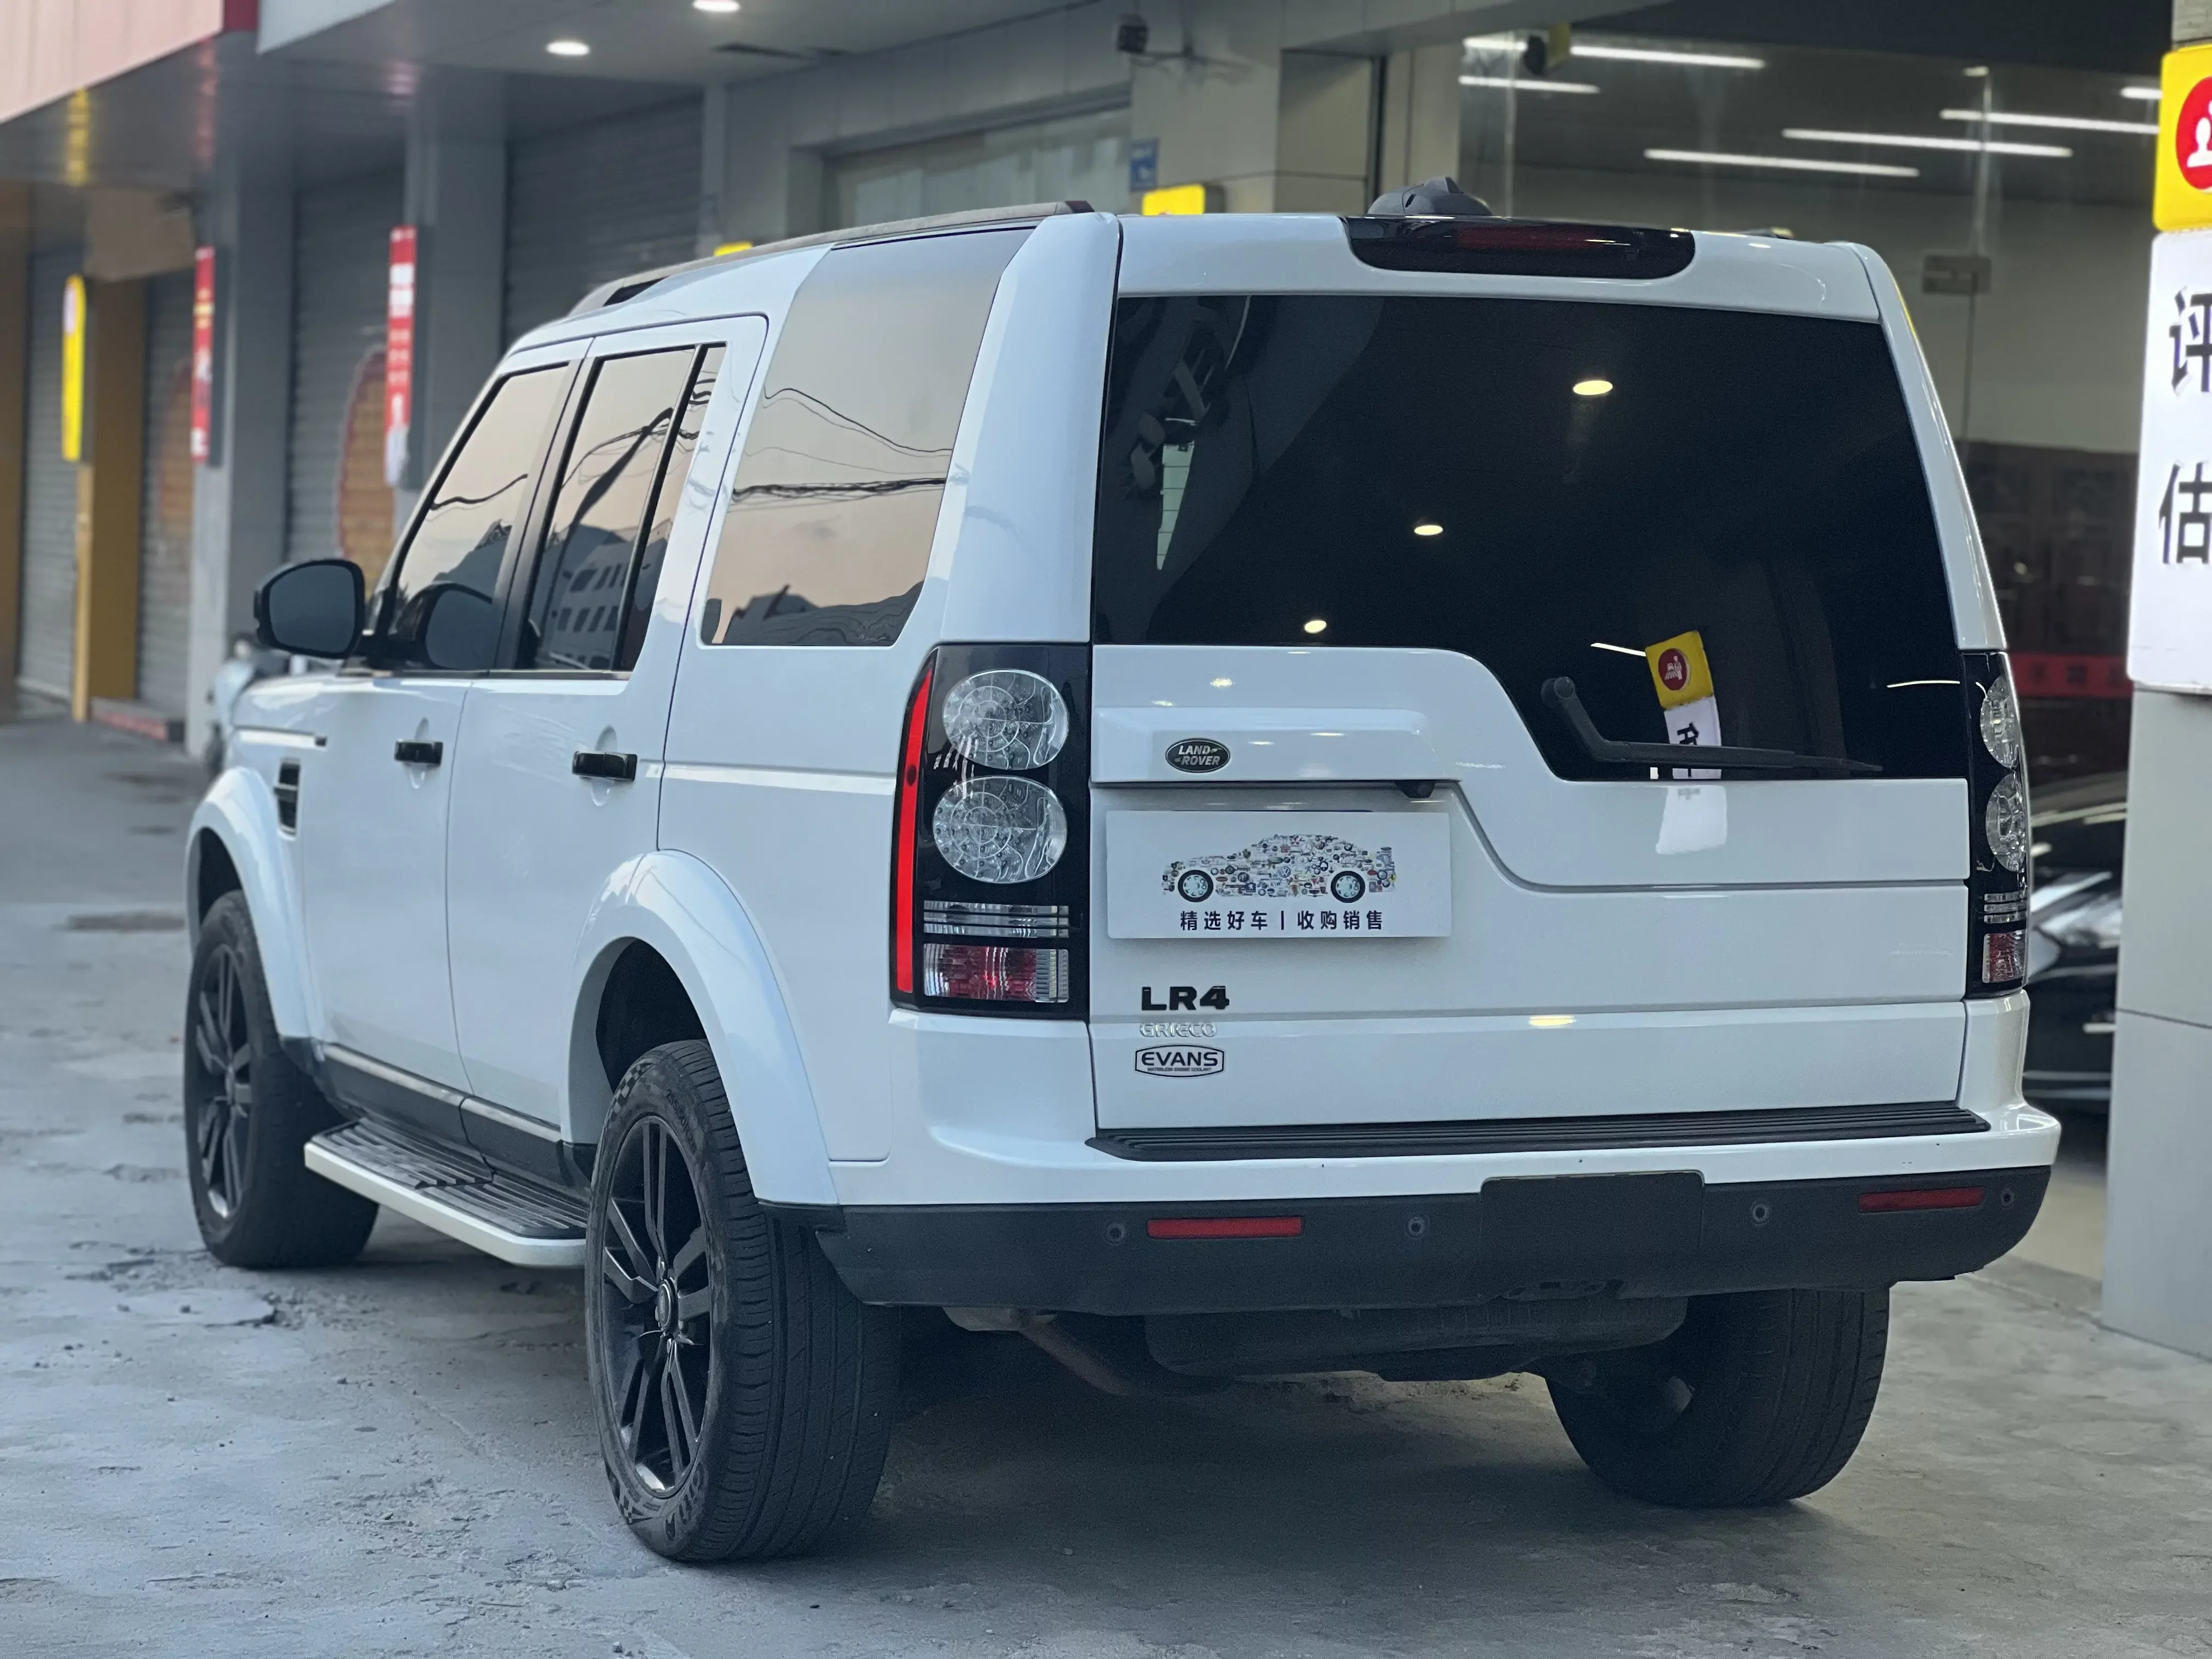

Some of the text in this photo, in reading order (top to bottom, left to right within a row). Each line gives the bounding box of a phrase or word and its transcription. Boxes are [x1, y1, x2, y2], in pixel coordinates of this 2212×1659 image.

[1178, 745, 1210, 755] LAND
[1181, 755, 1221, 765] ROVER
[1142, 985, 1230, 1011] LR4
[1139, 1022, 1216, 1037] GRIECO
[1142, 1052, 1218, 1066] EVANS
